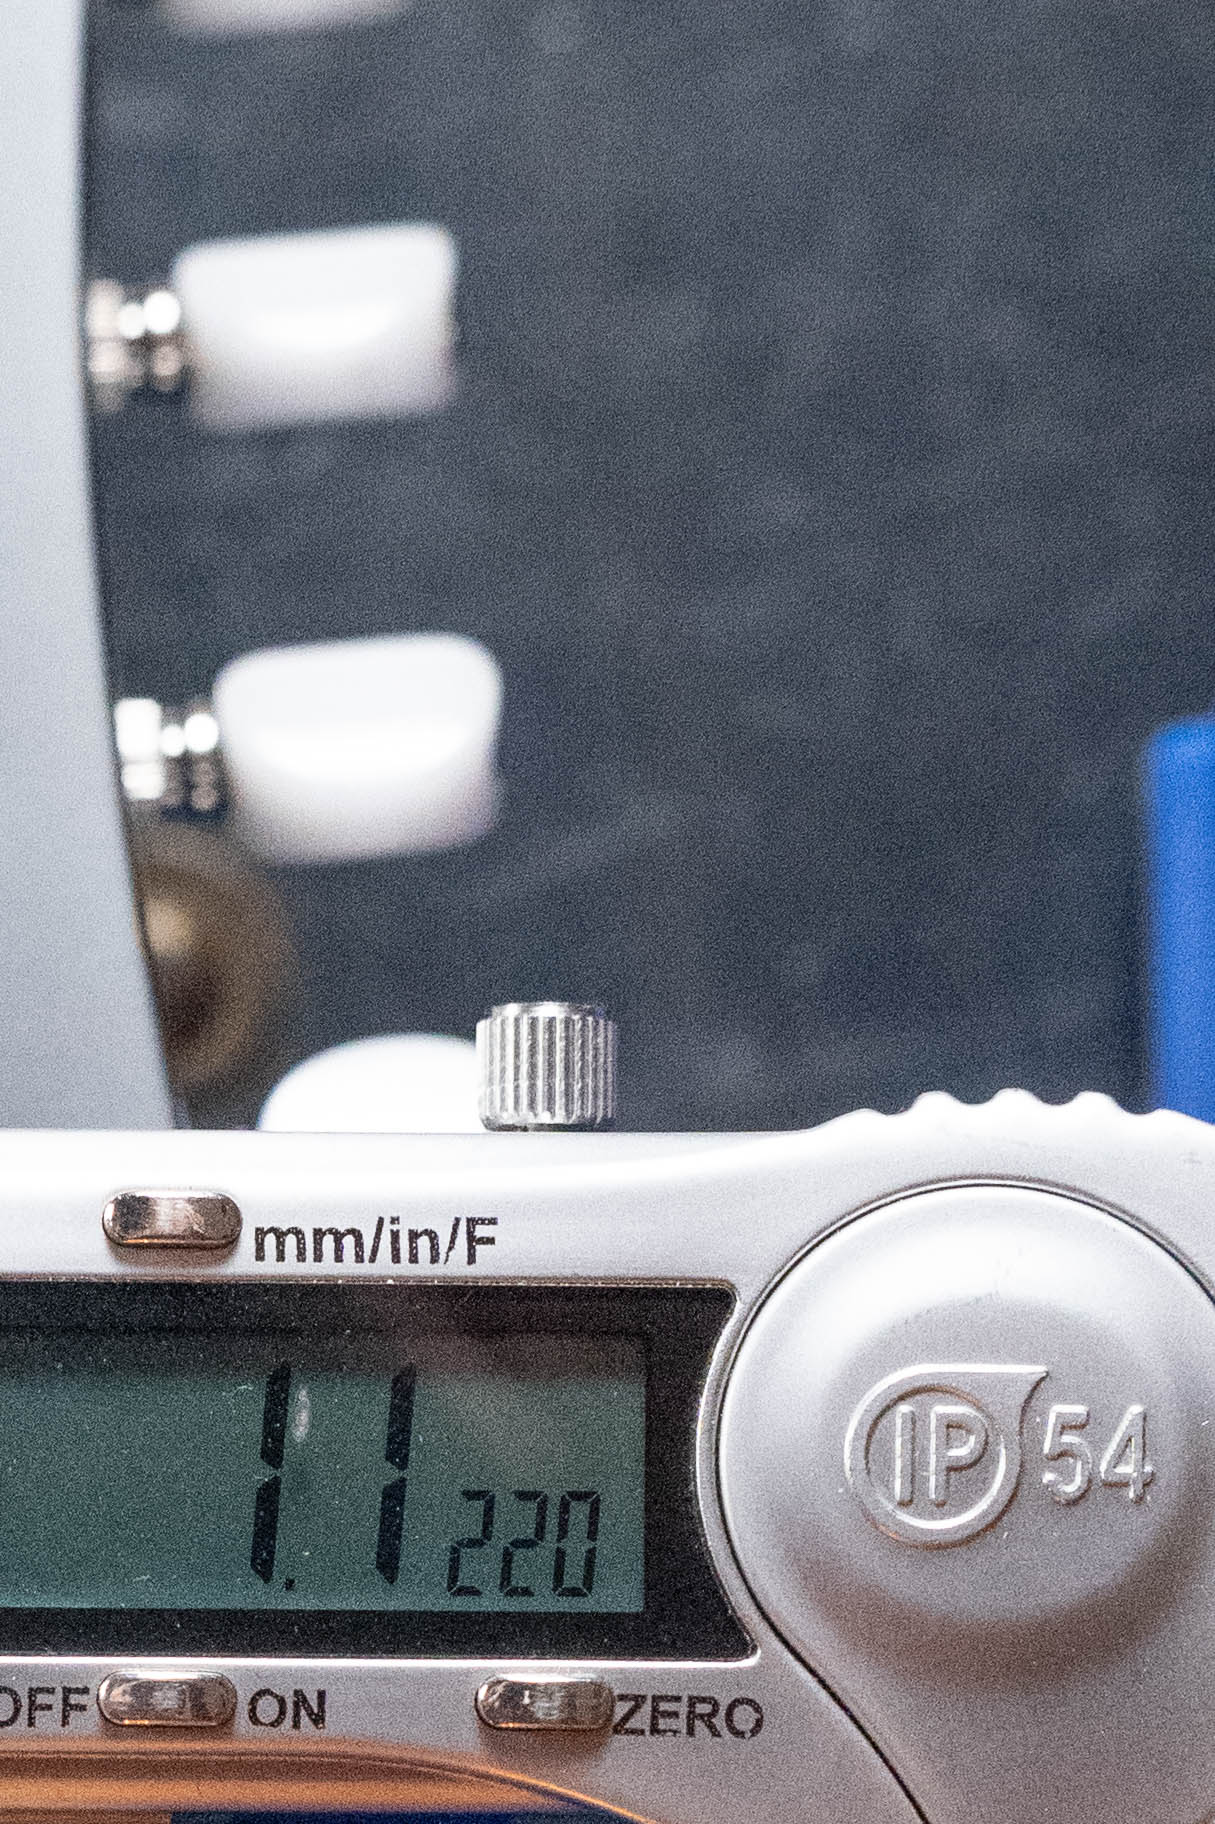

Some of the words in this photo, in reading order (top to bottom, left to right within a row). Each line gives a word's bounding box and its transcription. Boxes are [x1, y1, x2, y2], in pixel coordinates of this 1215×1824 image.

[254, 1216, 499, 1265] mm/in/F
[892, 1404, 990, 1507] IP
[1042, 1404, 1154, 1505] 54
[247, 1689, 327, 1730] ON
[611, 1693, 764, 1739] ZERO
